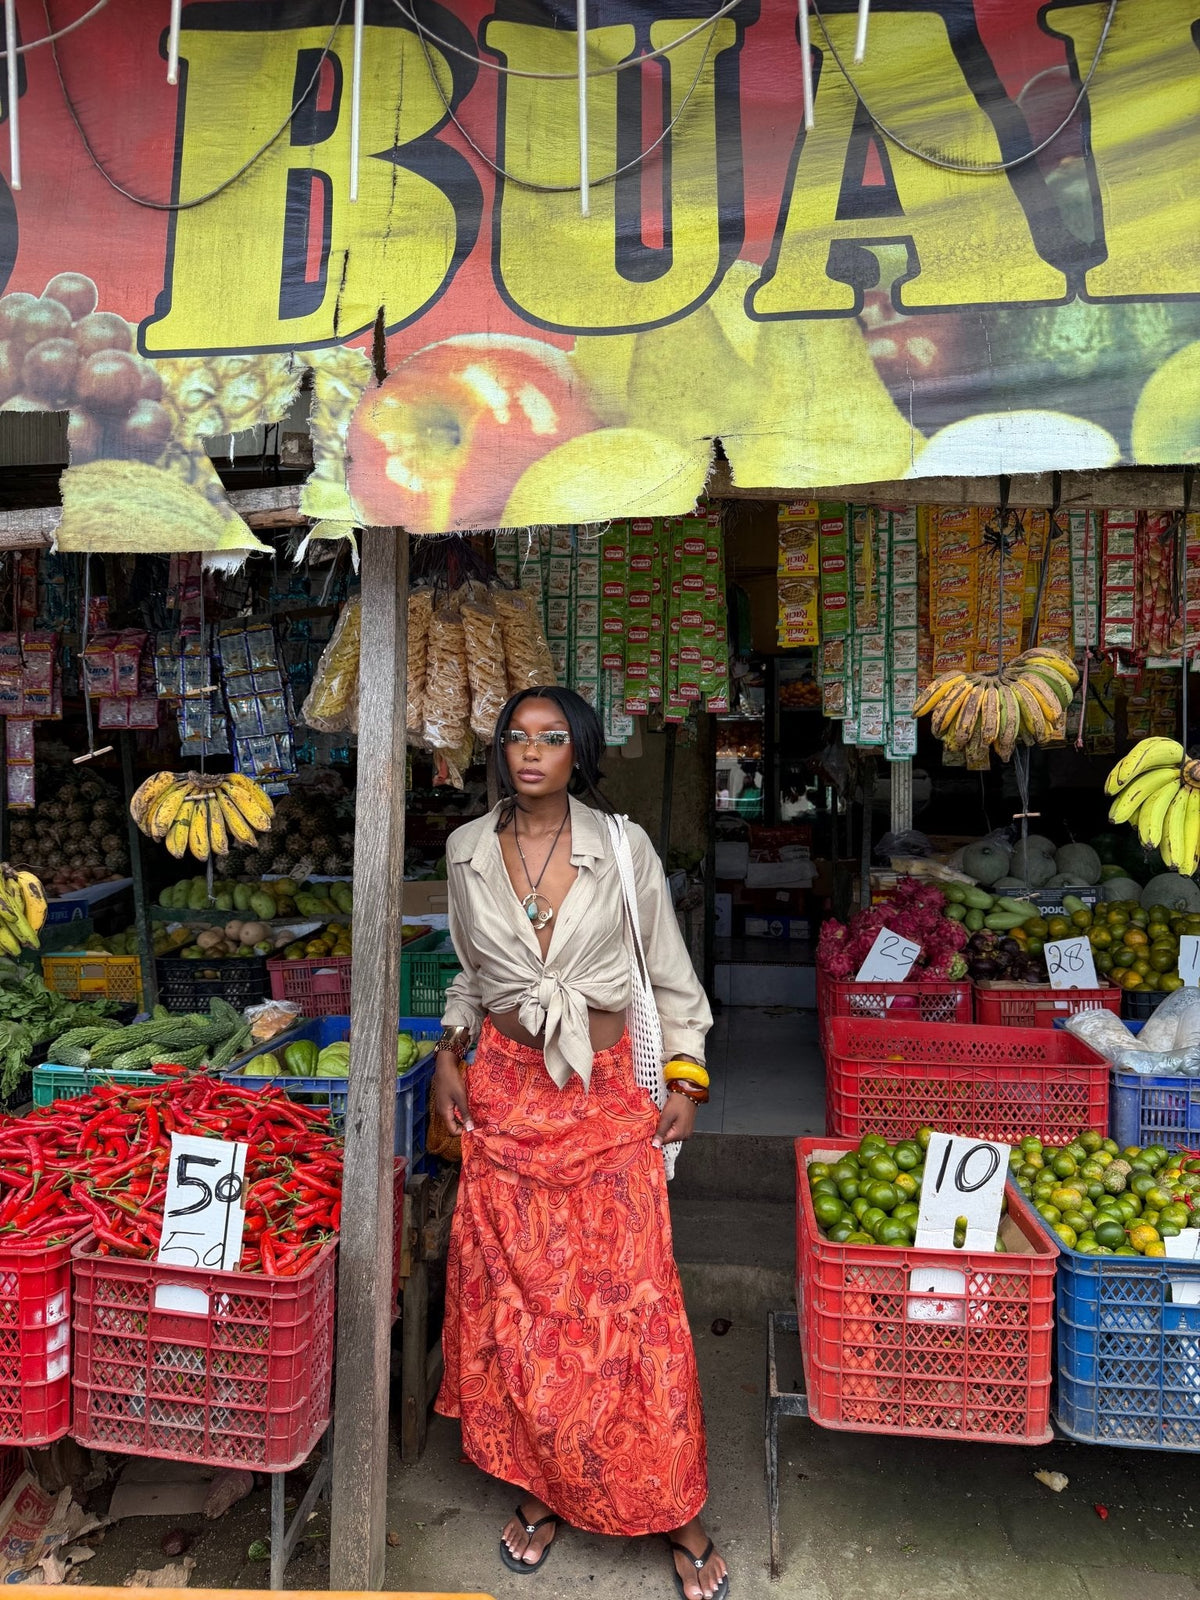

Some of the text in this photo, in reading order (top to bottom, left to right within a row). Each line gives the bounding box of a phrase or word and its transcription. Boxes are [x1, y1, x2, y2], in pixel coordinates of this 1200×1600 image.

[785, 554, 808, 565] Racik
[785, 610, 808, 620] Racik
[1041, 631, 1068, 641] Masako
[879, 935, 918, 966] 25
[1049, 943, 1085, 974] 28
[935, 1139, 1001, 1193] 10
